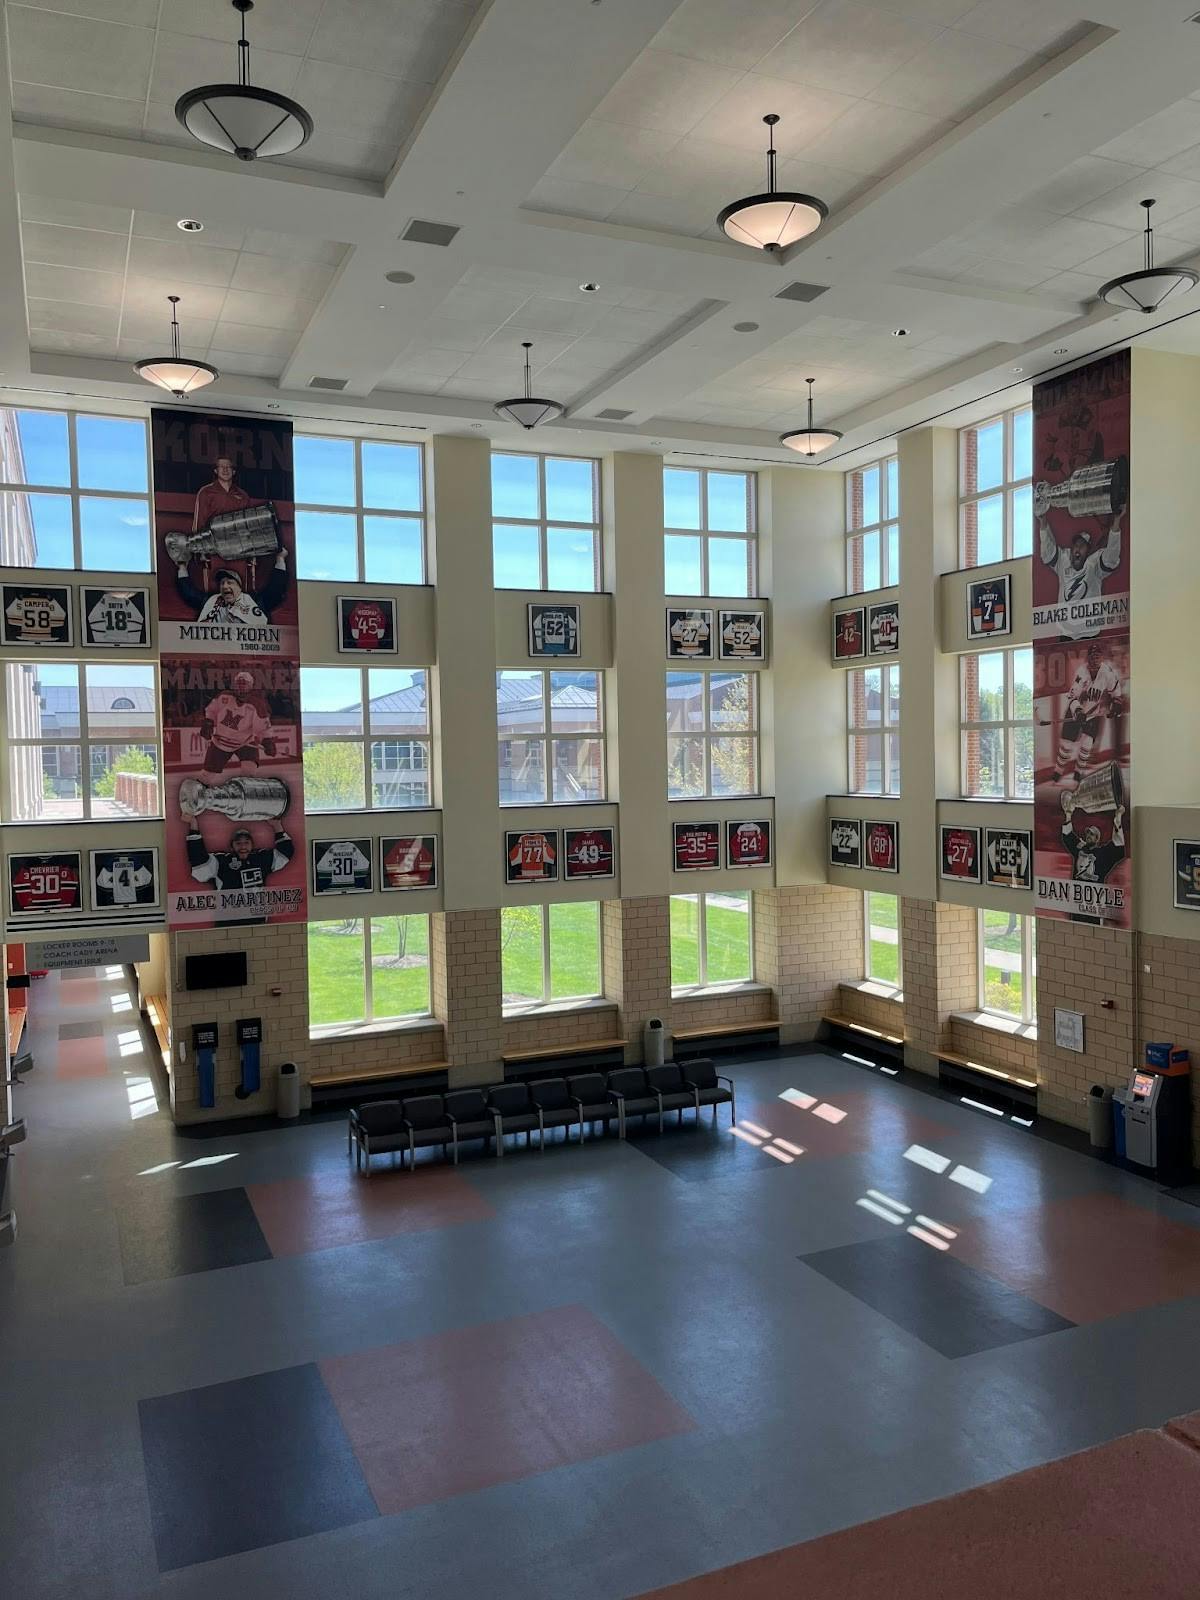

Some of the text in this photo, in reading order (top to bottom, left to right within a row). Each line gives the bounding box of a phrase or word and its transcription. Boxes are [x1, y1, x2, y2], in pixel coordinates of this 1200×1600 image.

[24, 600, 50, 608] CAMPER
[984, 601, 993, 620] 7
[1033, 598, 1128, 625] BLAKE COLEMAN
[24, 610, 50, 629] 58
[104, 611, 127, 631] 18
[358, 617, 378, 635] 45
[546, 620, 564, 636] 52
[879, 620, 892, 636] 40
[1086, 617, 1105, 627] CLASS
[1107, 616, 1115, 624] OF
[179, 625, 280, 642] MITCH KORN
[682, 628, 698, 643] 27
[734, 631, 750, 645] 52
[843, 627, 855, 643] 42
[687, 837, 706, 854] 35
[741, 837, 757, 852] 24
[839, 833, 850, 848] 22
[523, 847, 543, 863] 77
[579, 845, 600, 864] 49
[952, 845, 968, 864] 27
[1000, 847, 1017, 867] 83
[30, 865, 60, 875] CHEVRIER
[333, 857, 353, 876] 30
[30, 874, 60, 895] 30
[118, 869, 129, 887] 4
[176, 889, 303, 911] ALEC MARTINEZ
[1038, 879, 1124, 907] DAN BOYLE
[43, 942, 71, 950] LOCKER
[72, 940, 97, 948] ROOMS
[43, 947, 118, 959] COACH CADY ARENA
[43, 958, 82, 968] EQUIPMENT
